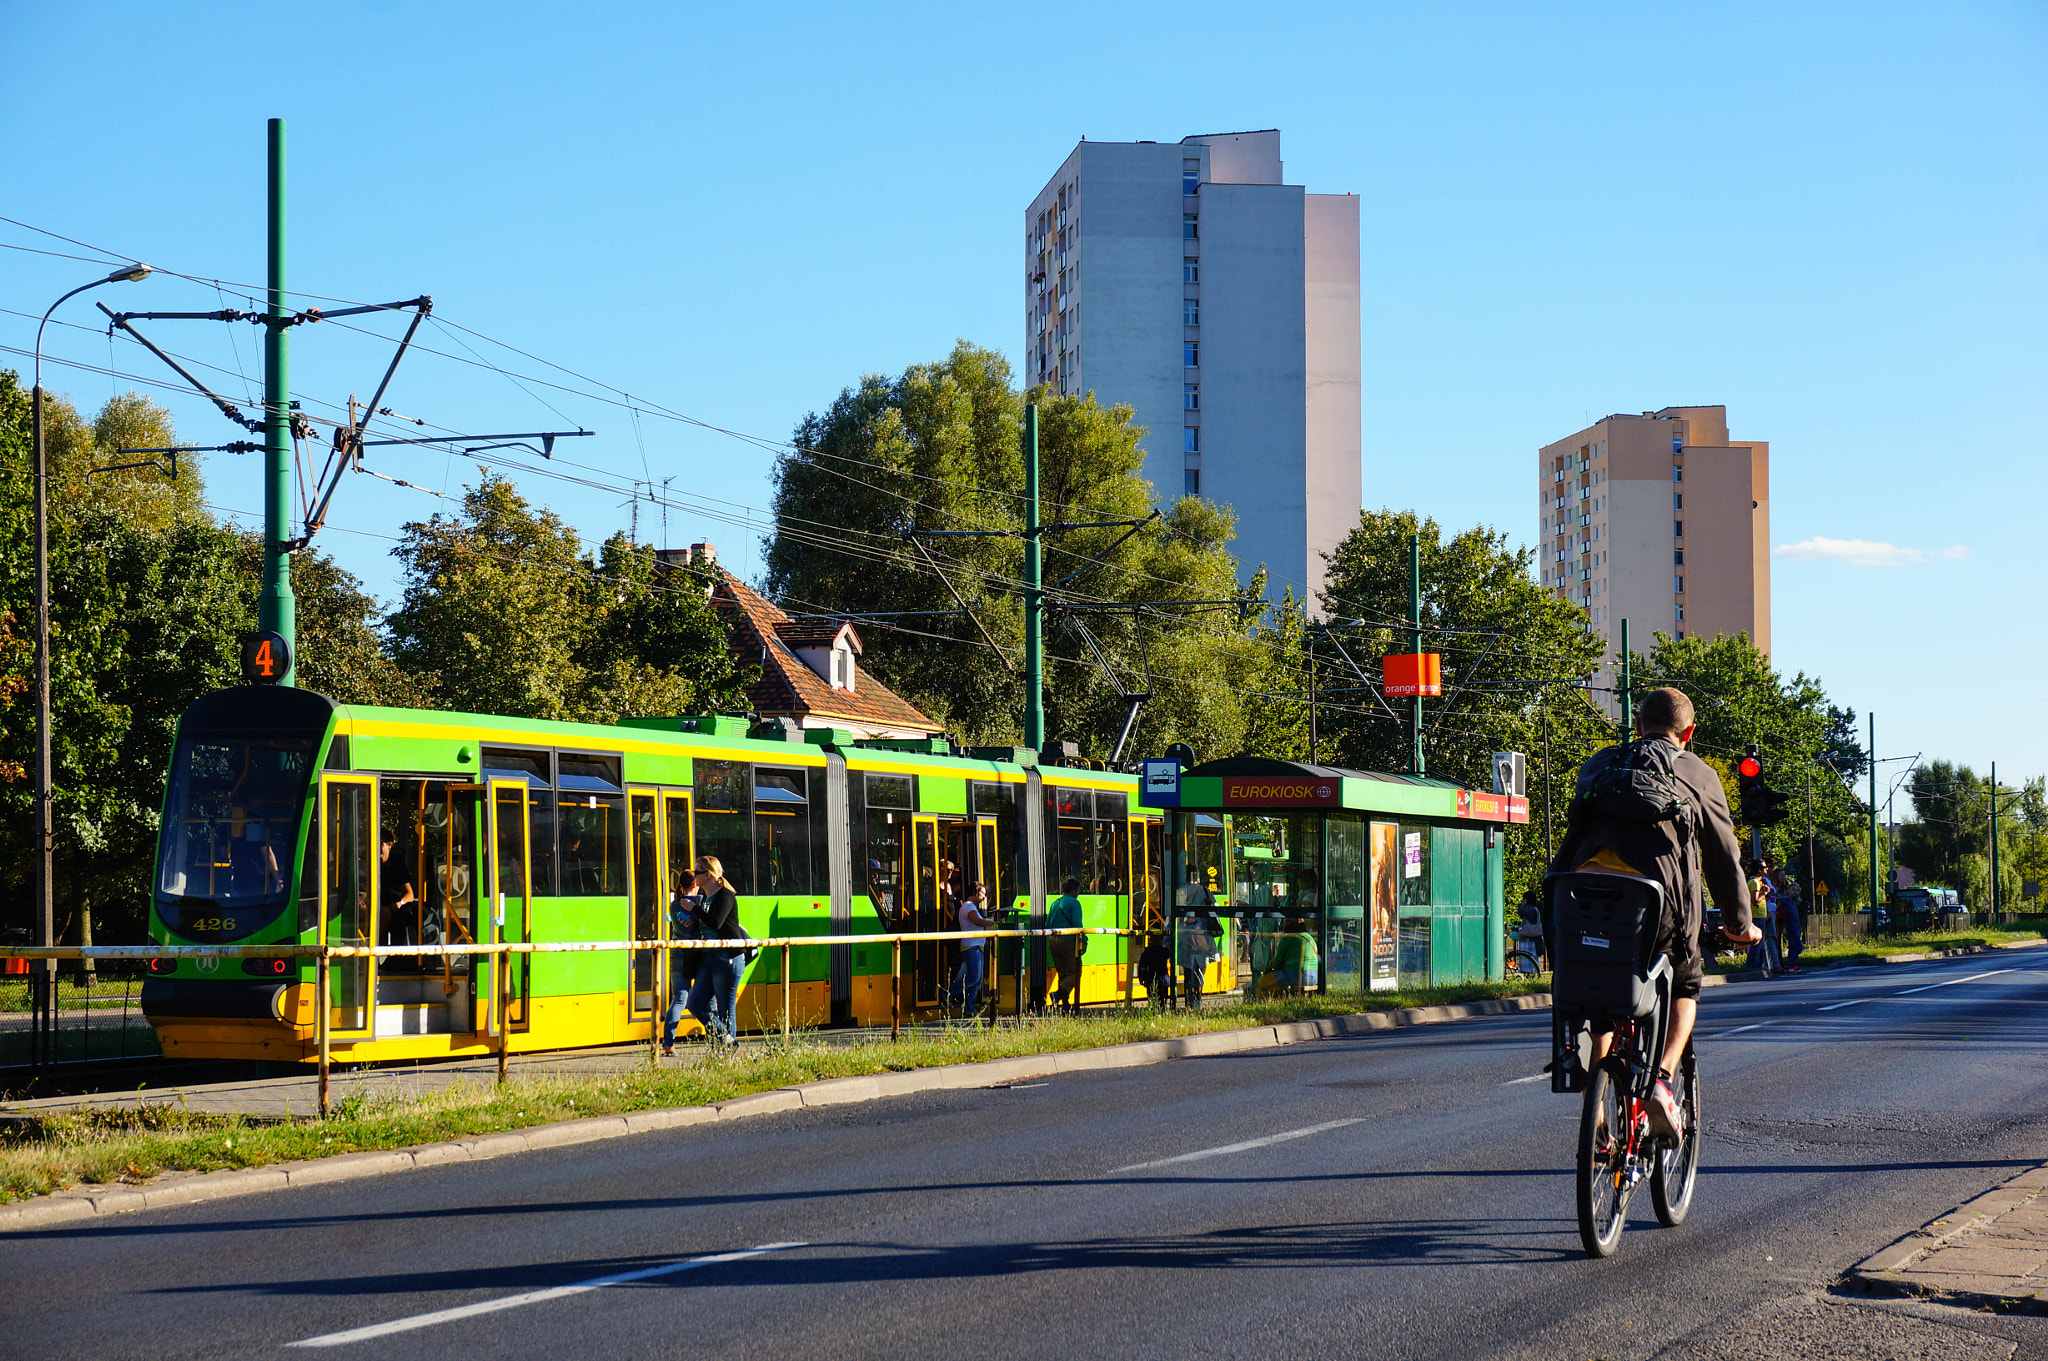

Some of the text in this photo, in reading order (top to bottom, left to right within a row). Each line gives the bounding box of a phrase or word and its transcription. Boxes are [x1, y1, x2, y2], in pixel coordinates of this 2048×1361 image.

[255, 640, 274, 677] 4
[1385, 684, 1416, 694] orange
[1230, 785, 1315, 798] EUROKIOSK
[192, 917, 237, 931] 426
